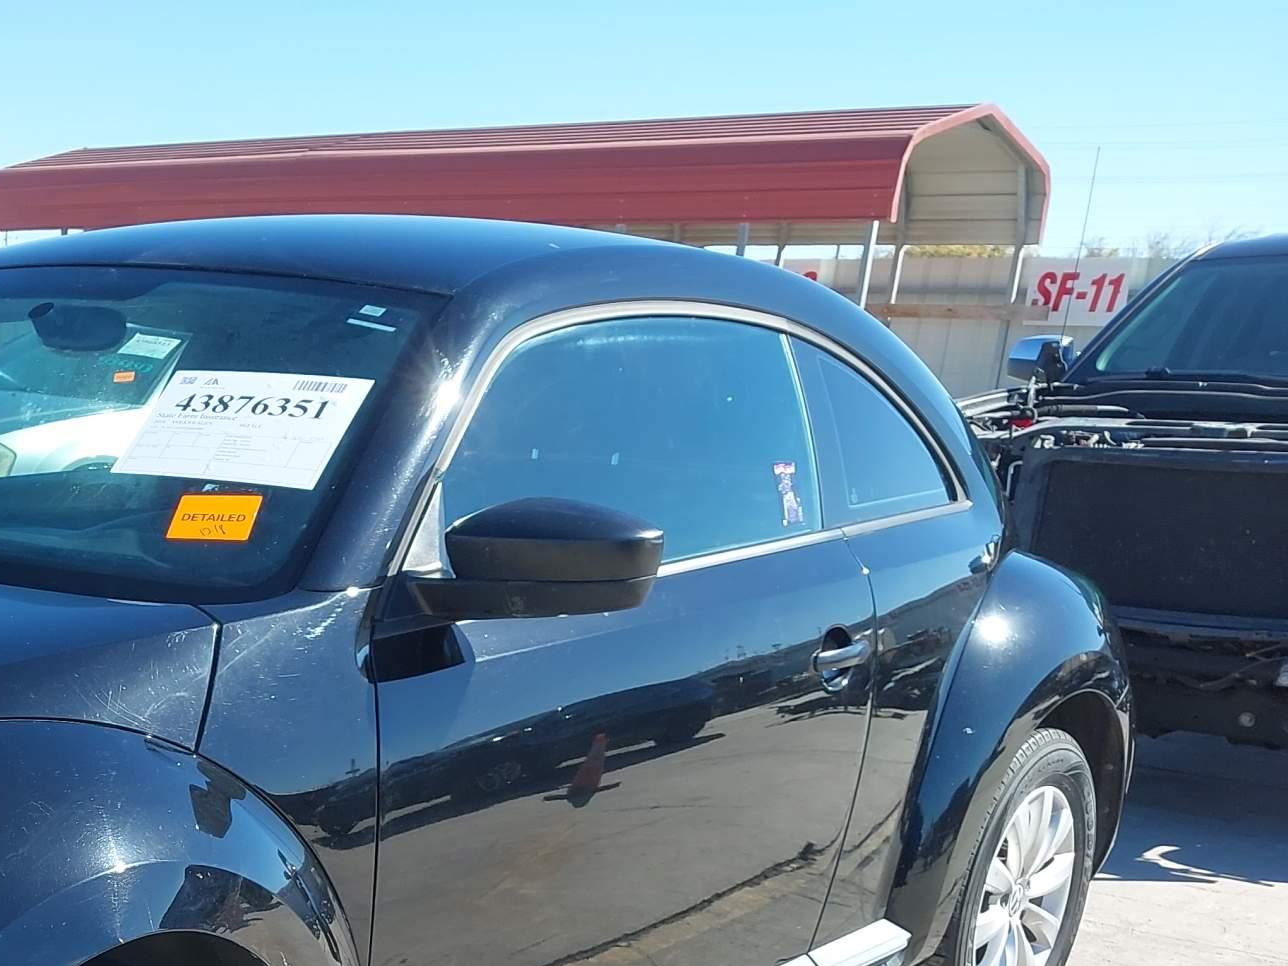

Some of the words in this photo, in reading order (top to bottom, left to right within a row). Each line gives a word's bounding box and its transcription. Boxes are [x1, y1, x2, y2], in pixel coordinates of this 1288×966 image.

[1031, 271, 1126, 312] SF-11
[175, 392, 329, 420] 43876351
[181, 513, 246, 522] DETAILED
